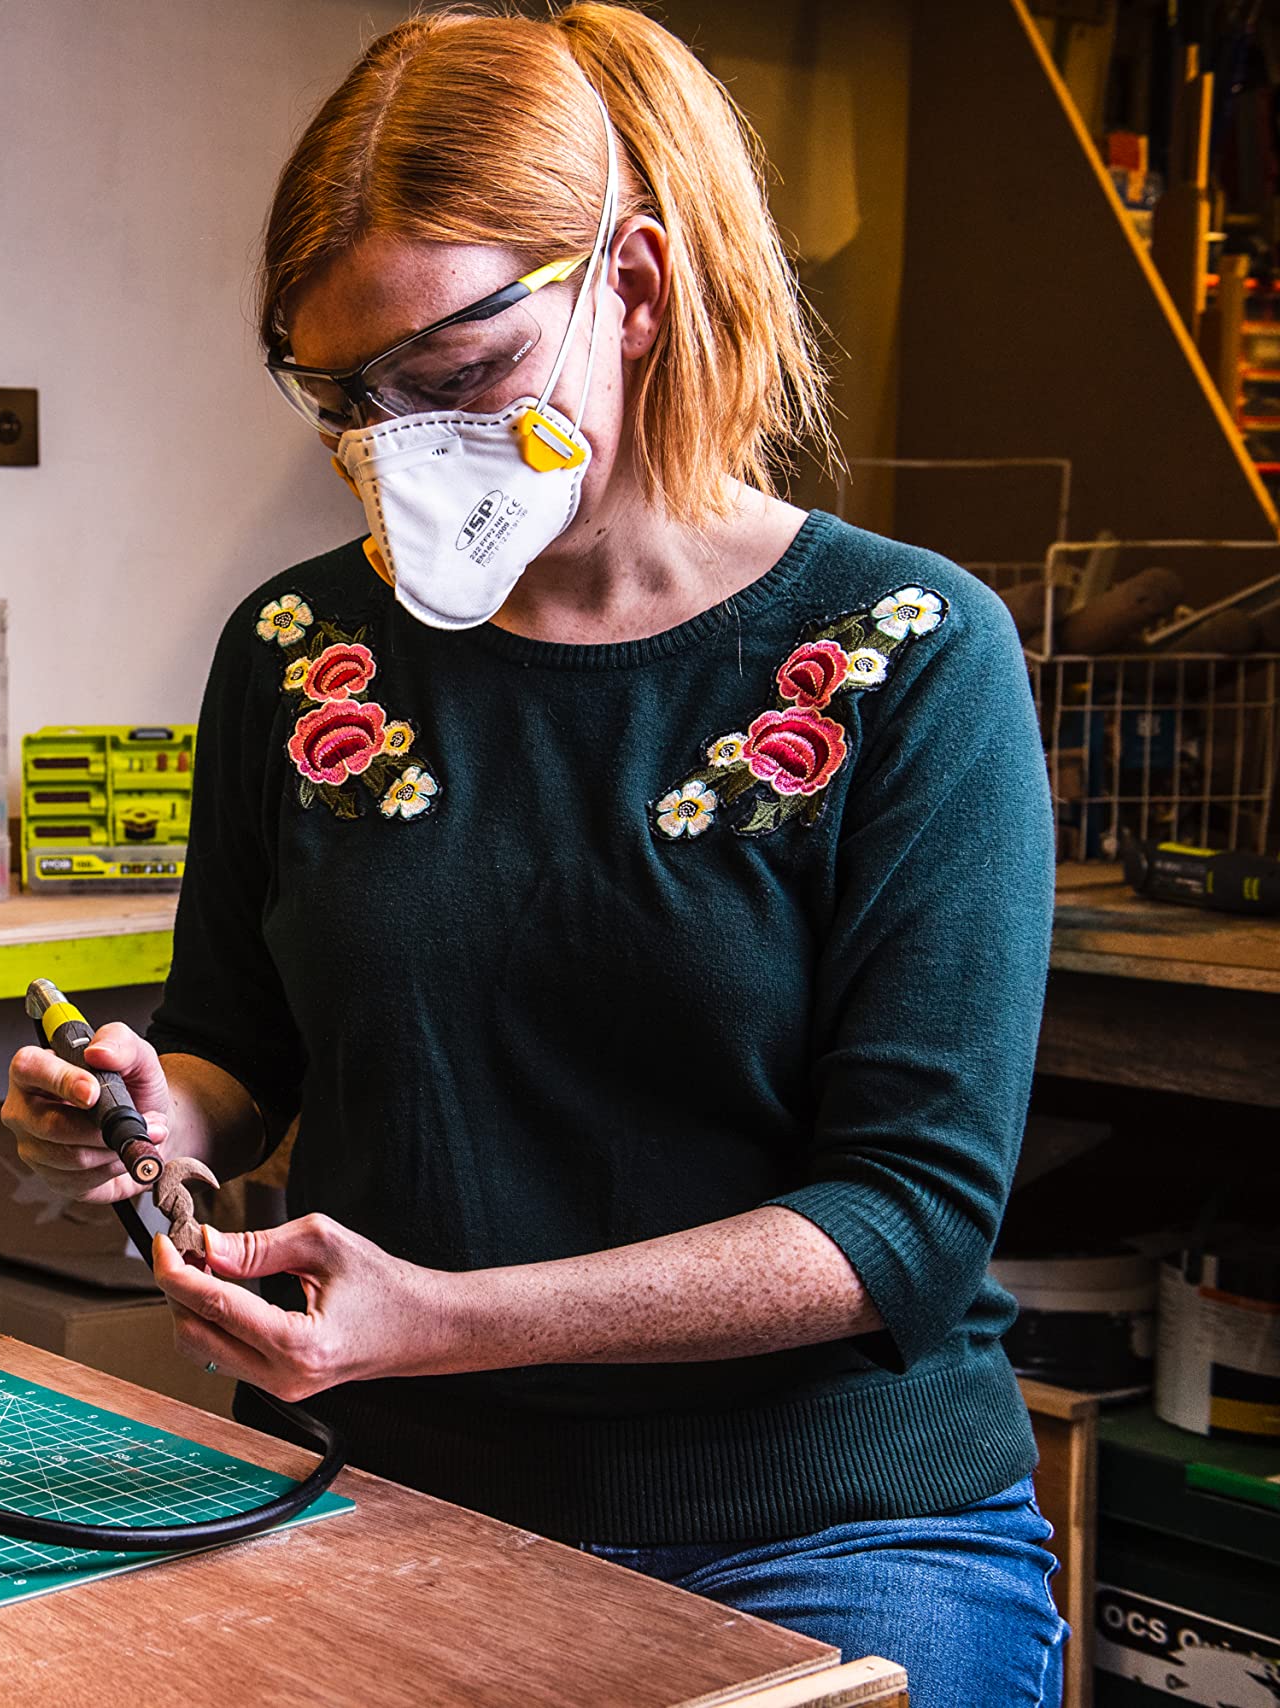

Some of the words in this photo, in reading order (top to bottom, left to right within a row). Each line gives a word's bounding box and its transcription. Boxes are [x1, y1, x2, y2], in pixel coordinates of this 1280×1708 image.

[512, 340, 533, 362] RYOBI
[463, 499, 493, 545] JSP
[495, 522, 510, 540] 2009
[470, 546, 482, 560] 222
[480, 528, 496, 546] FFP2
[14, 1578, 28, 1586] 6
[1103, 1604, 1168, 1644] OCS
